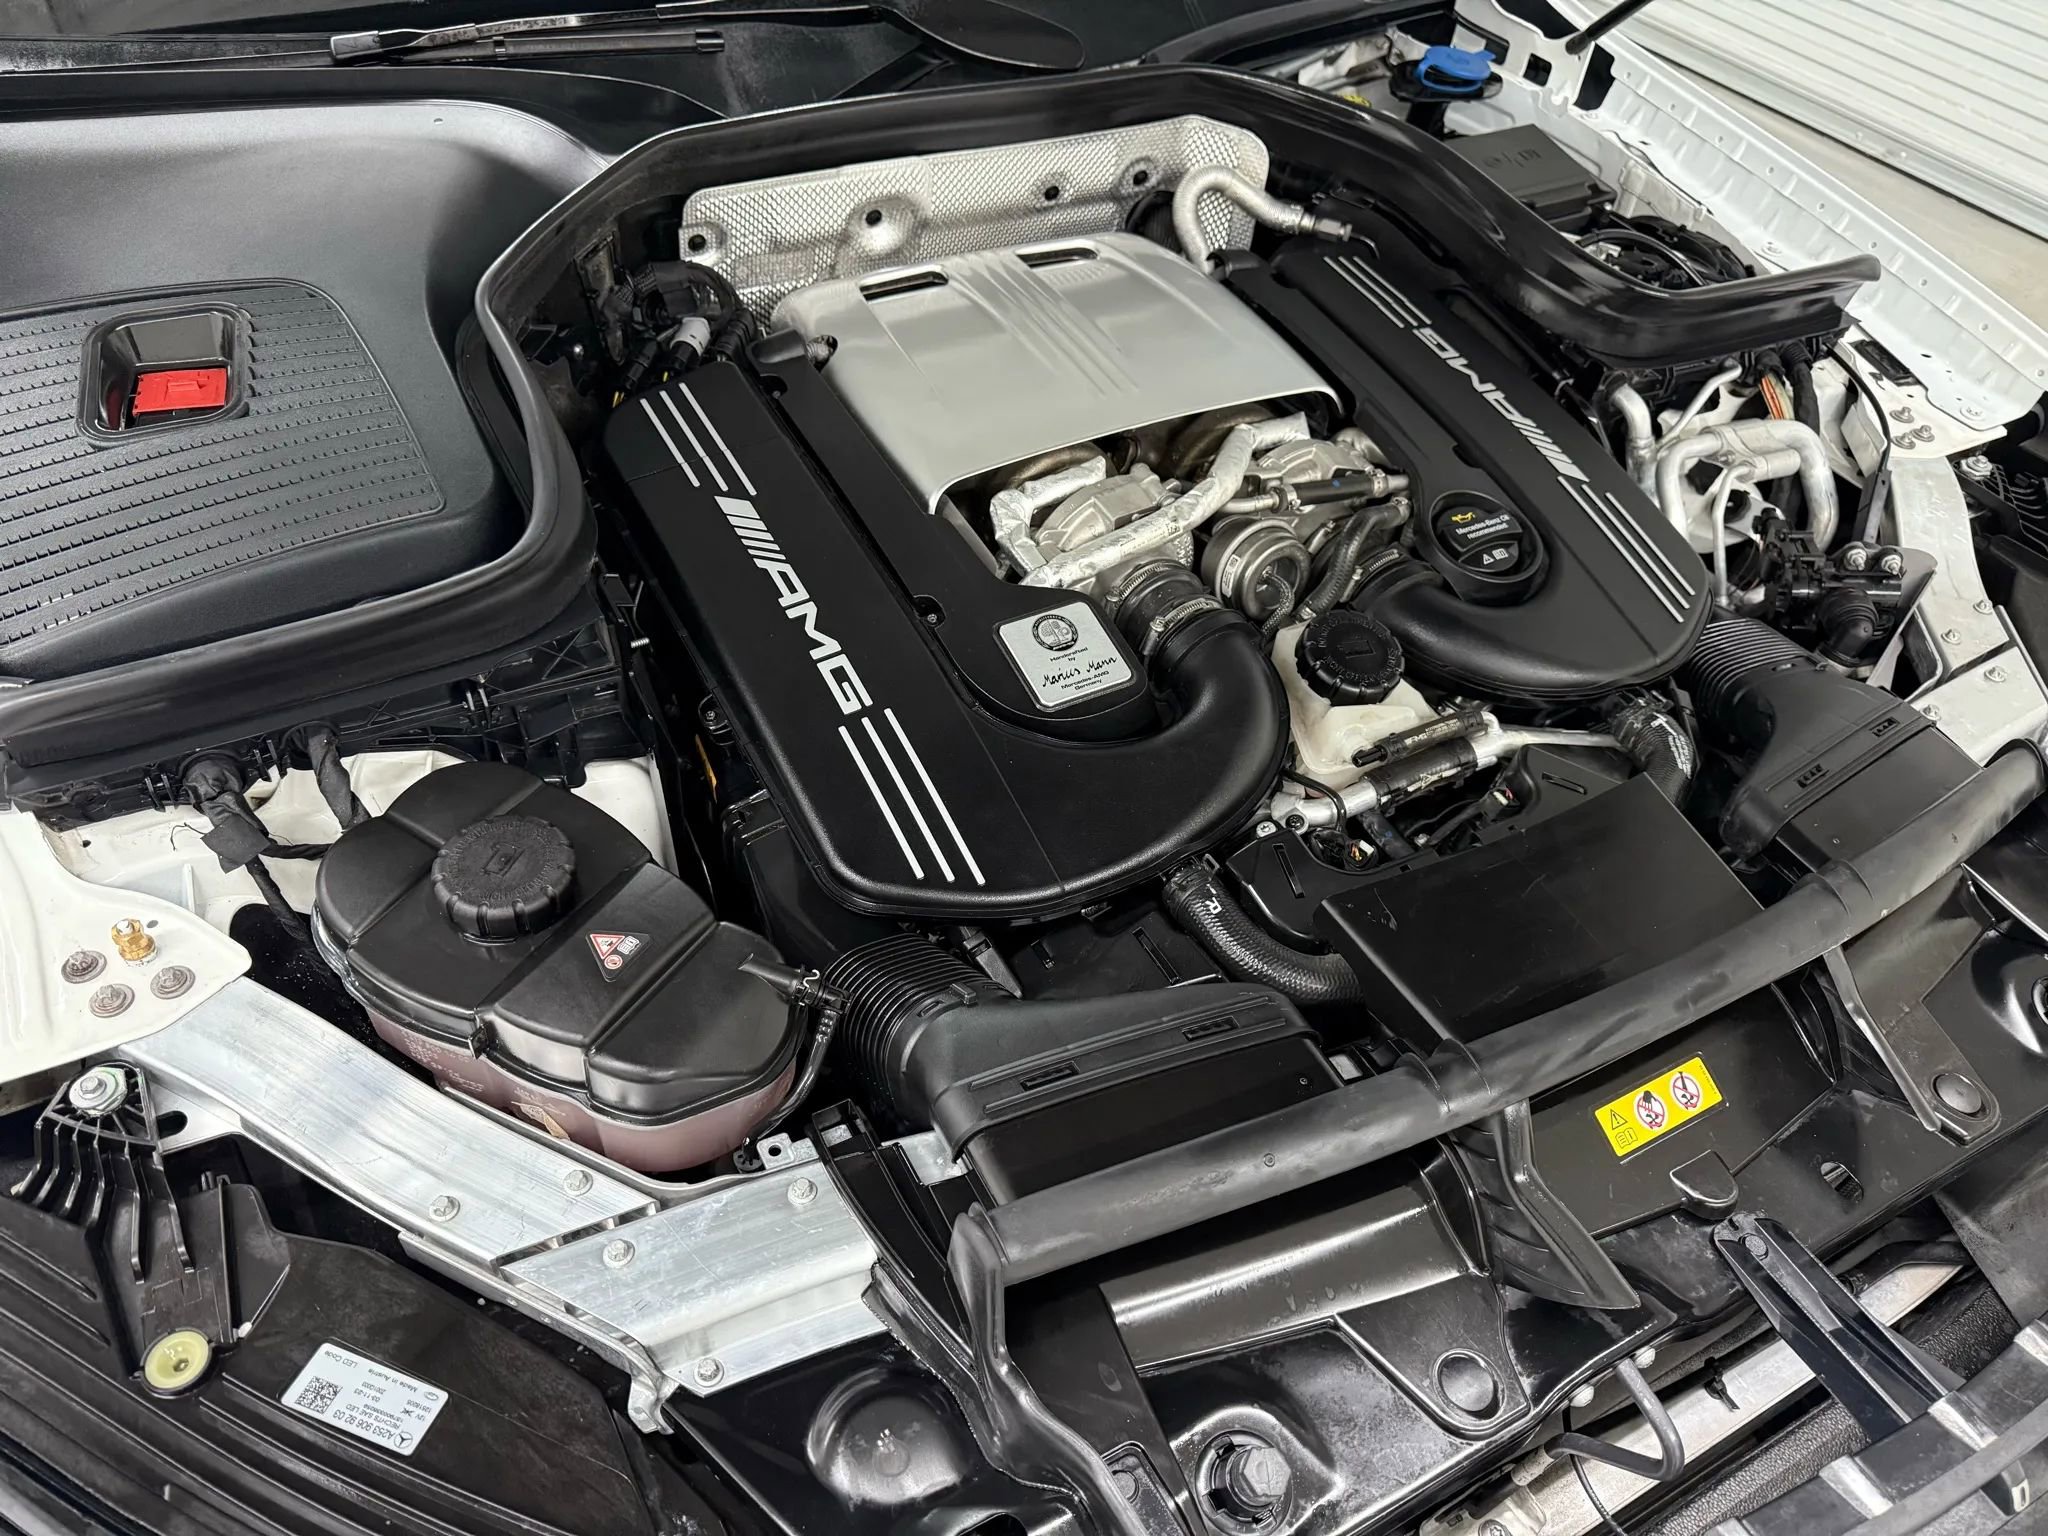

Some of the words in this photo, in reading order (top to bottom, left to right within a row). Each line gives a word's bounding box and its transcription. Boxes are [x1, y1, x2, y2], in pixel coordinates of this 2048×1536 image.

[1413, 325, 1533, 432] AMG
[1456, 518, 1500, 535] Mercedes-Benz
[752, 556, 875, 717] AMG
[1050, 647, 1088, 662] Handcrafted
[1086, 658, 1117, 672] Mann
[1061, 671, 1109, 689] Mercedes-AMG
[1074, 680, 1102, 691] Germany
[324, 1350, 342, 1361] Code
[342, 1358, 358, 1368] LED
[368, 1368, 390, 1381] Austria
[398, 1381, 418, 1392] Made
[345, 1403, 359, 1413] LED
[332, 1409, 346, 1420] 03
[343, 1414, 357, 1424] 92
[355, 1420, 373, 1431] 906
[372, 1425, 396, 1439] A253
